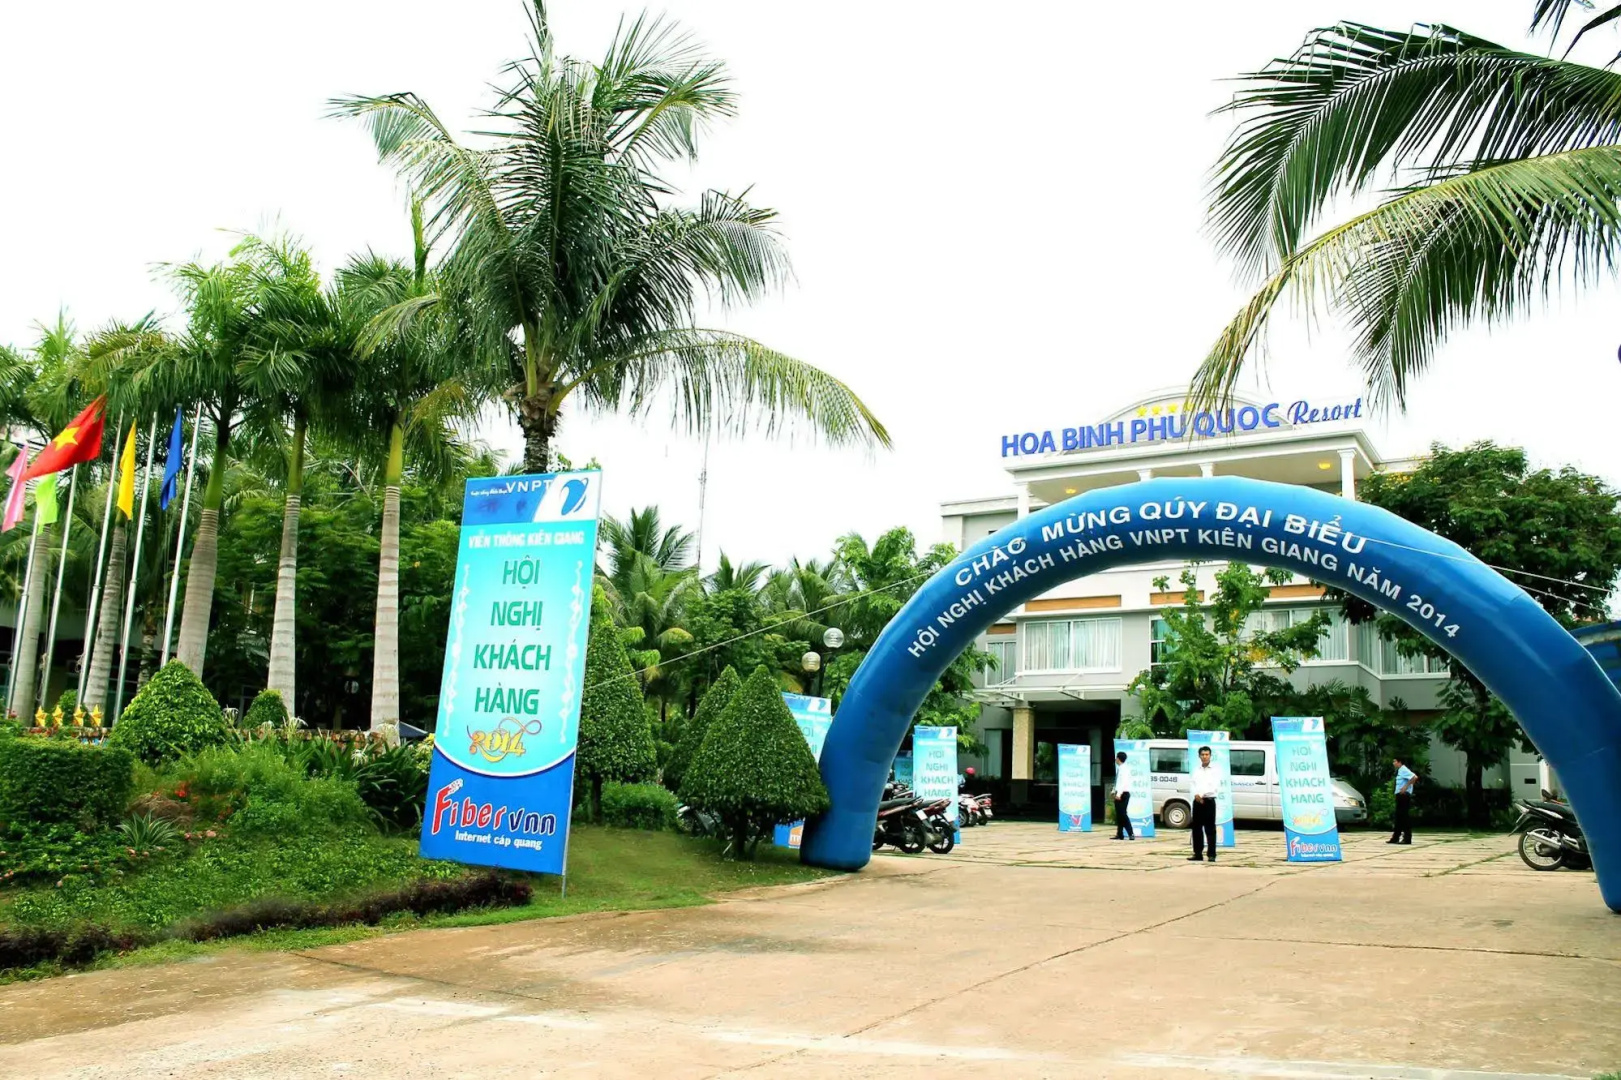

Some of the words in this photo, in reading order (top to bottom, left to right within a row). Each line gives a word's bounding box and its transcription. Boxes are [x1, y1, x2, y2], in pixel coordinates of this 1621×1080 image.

[1002, 430, 1056, 457] HOA
[1062, 421, 1124, 451] BINH
[1130, 414, 1187, 442] PHU
[1194, 403, 1280, 437] QUOC
[1287, 397, 1362, 425] Resort
[505, 479, 551, 493] VNPT
[955, 537, 1026, 587] CHÀO
[1041, 506, 1131, 543] MỪNG
[1139, 496, 1208, 521] QÚY
[1215, 501, 1273, 528] ĐẠI
[1284, 513, 1367, 554] BIỂU
[502, 555, 541, 589] HỘI
[907, 625, 940, 658] HỘI
[936, 589, 987, 629] NGHỊ
[984, 553, 1056, 595] KHÁCH
[1059, 534, 1124, 563] HÀNG
[1129, 528, 1189, 546] VNPT
[1197, 527, 1252, 549] KIÊN
[1261, 538, 1338, 571] GIANG
[1347, 562, 1402, 601] NĂM
[1406, 594, 1460, 638] 2014
[490, 600, 544, 631] NGHỊ
[473, 638, 552, 671] KHÁCH
[474, 681, 540, 715] HÀNG
[467, 719, 540, 763] 2014
[454, 830, 492, 845] Internet
[493, 833, 511, 848] cáp
[513, 837, 543, 851] quang
